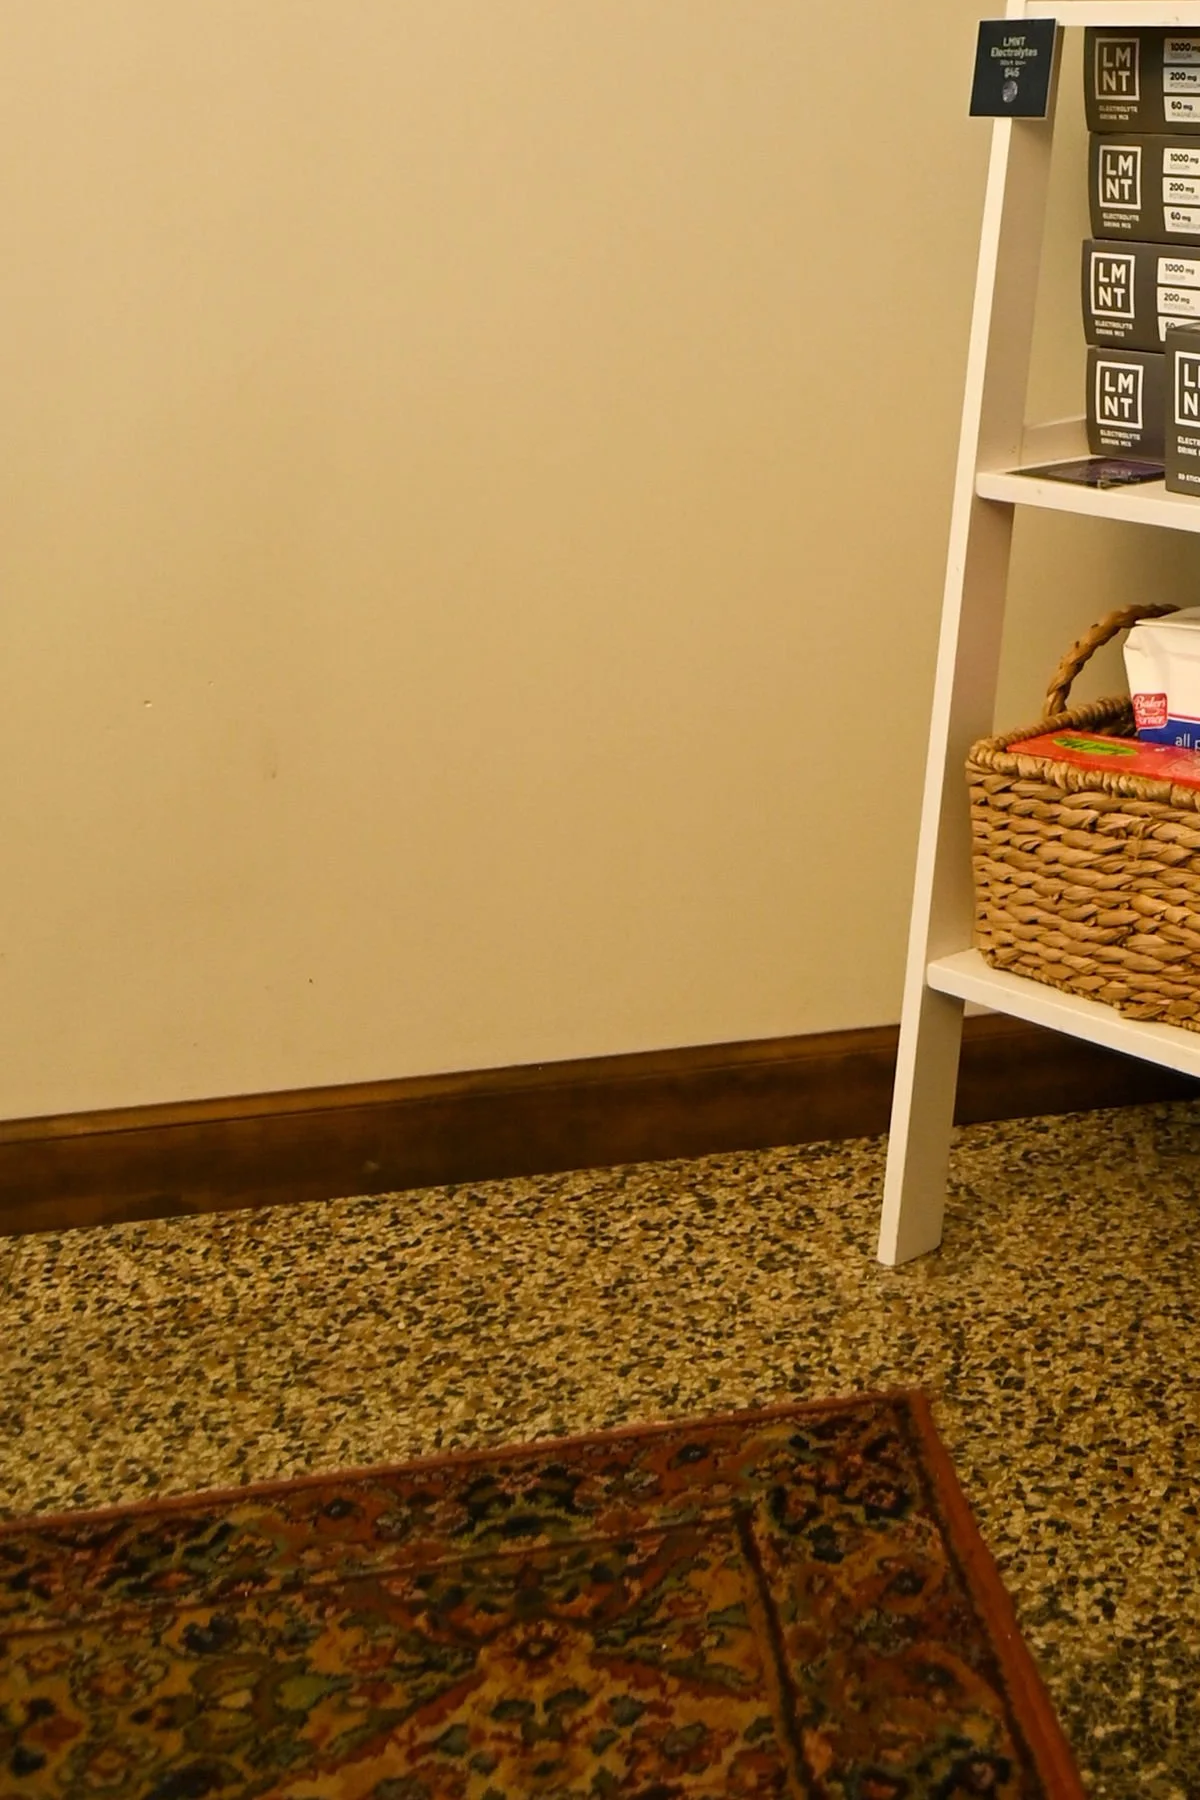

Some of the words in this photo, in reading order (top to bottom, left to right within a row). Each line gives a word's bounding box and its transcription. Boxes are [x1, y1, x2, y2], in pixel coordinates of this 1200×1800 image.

[1003, 37, 1026, 47] LMNT
[1171, 43, 1190, 52] 1000
[991, 47, 1038, 58] Electrolytes
[1103, 47, 1131, 68] LM
[1103, 70, 1130, 92] NT
[1170, 72, 1186, 81] 200
[1187, 74, 1197, 82] mg
[1099, 104, 1138, 113] ELECTROLYTE
[1171, 101, 1182, 110] 60
[1170, 153, 1189, 162] 1000
[1189, 156, 1199, 164] mg
[1106, 154, 1133, 177] LM
[1106, 178, 1132, 200] NT
[1169, 182, 1185, 192] 200
[1185, 186, 1195, 194] mg
[1103, 212, 1139, 222] ELECTROLYTE
[1170, 211, 1181, 221] 60
[1099, 262, 1126, 284] LM
[1165, 263, 1184, 273] 1000
[1185, 267, 1195, 275] mg
[1098, 286, 1126, 308] NT
[1164, 292, 1179, 302] 200
[1180, 296, 1190, 304] mg
[1095, 319, 1133, 329] ELECTROLYTE
[1104, 371, 1134, 395] LM
[1104, 396, 1133, 419] NT
[1100, 429, 1141, 441] ELECTROLYTE
[1120, 440, 1132, 448] MIX
[1175, 733, 1190, 747] all
